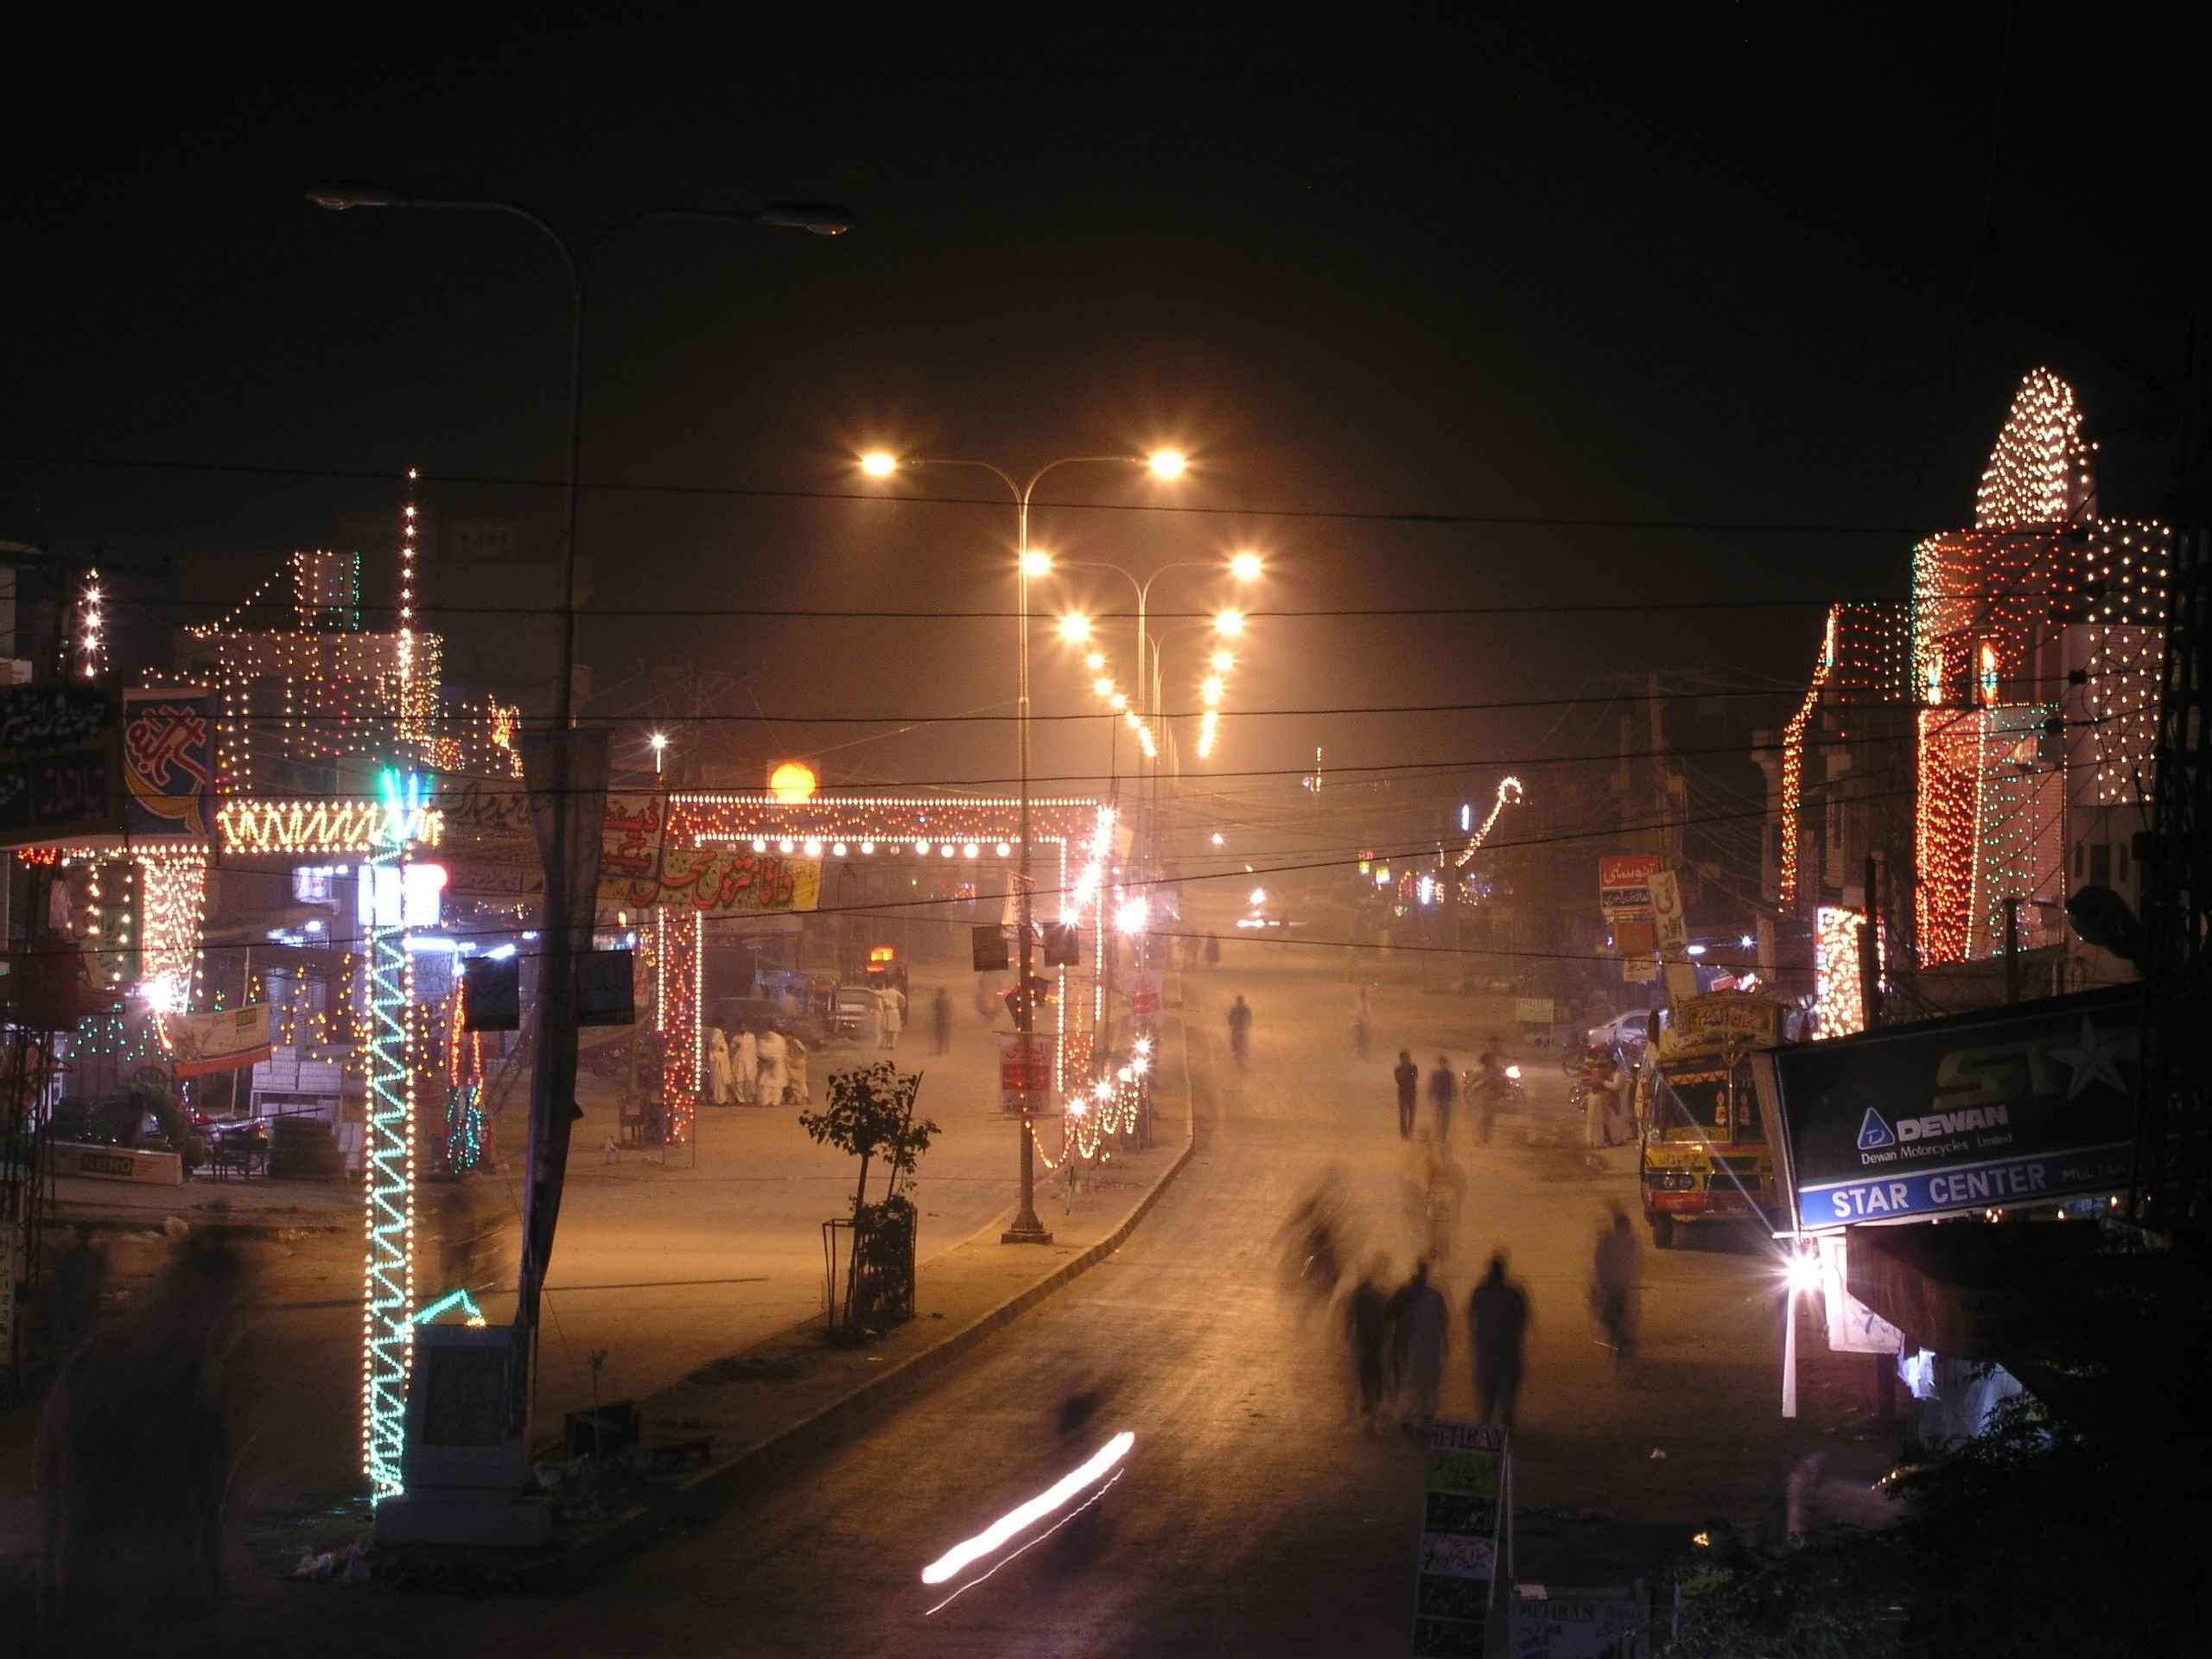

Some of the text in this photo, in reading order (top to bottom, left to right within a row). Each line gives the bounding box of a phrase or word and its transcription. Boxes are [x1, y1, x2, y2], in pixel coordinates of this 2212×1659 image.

[1896, 1103, 2009, 1142] DEWAN
[1861, 1133, 2012, 1166] Dewan Motorcycles Limited
[1831, 1182, 1910, 1218] STAR
[1929, 1163, 2046, 1204] CENTER
